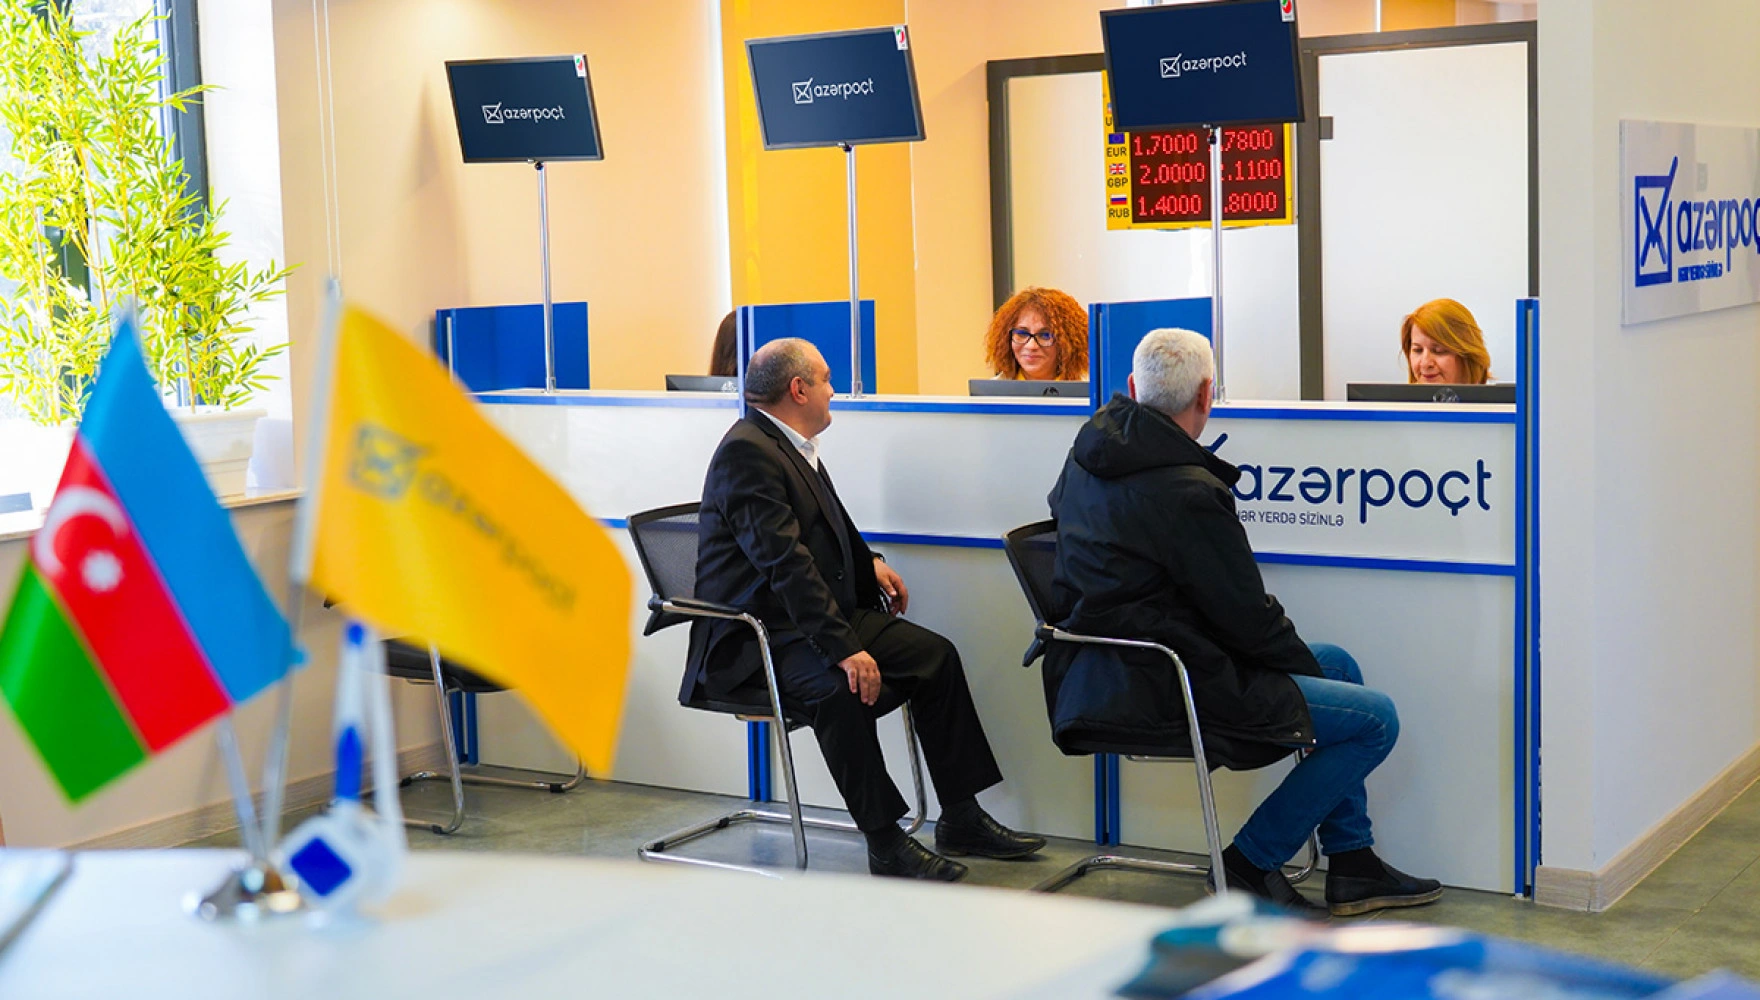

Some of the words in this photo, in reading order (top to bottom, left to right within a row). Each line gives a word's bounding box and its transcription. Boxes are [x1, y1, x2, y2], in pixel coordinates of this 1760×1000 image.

[1106, 147, 1127, 157] EUR
[1133, 133, 1198, 156] 1.7000
[1208, 129, 1273, 151] .7800
[1107, 178, 1128, 188] GBP
[1139, 162, 1205, 184] 2.0000
[1108, 207, 1130, 218] RUB
[1138, 194, 1202, 216] 1.4000
[1677, 197, 1760, 272] azərpoç
[1233, 459, 1492, 524] azərpoçt
[1258, 511, 1296, 524] YERDƏ
